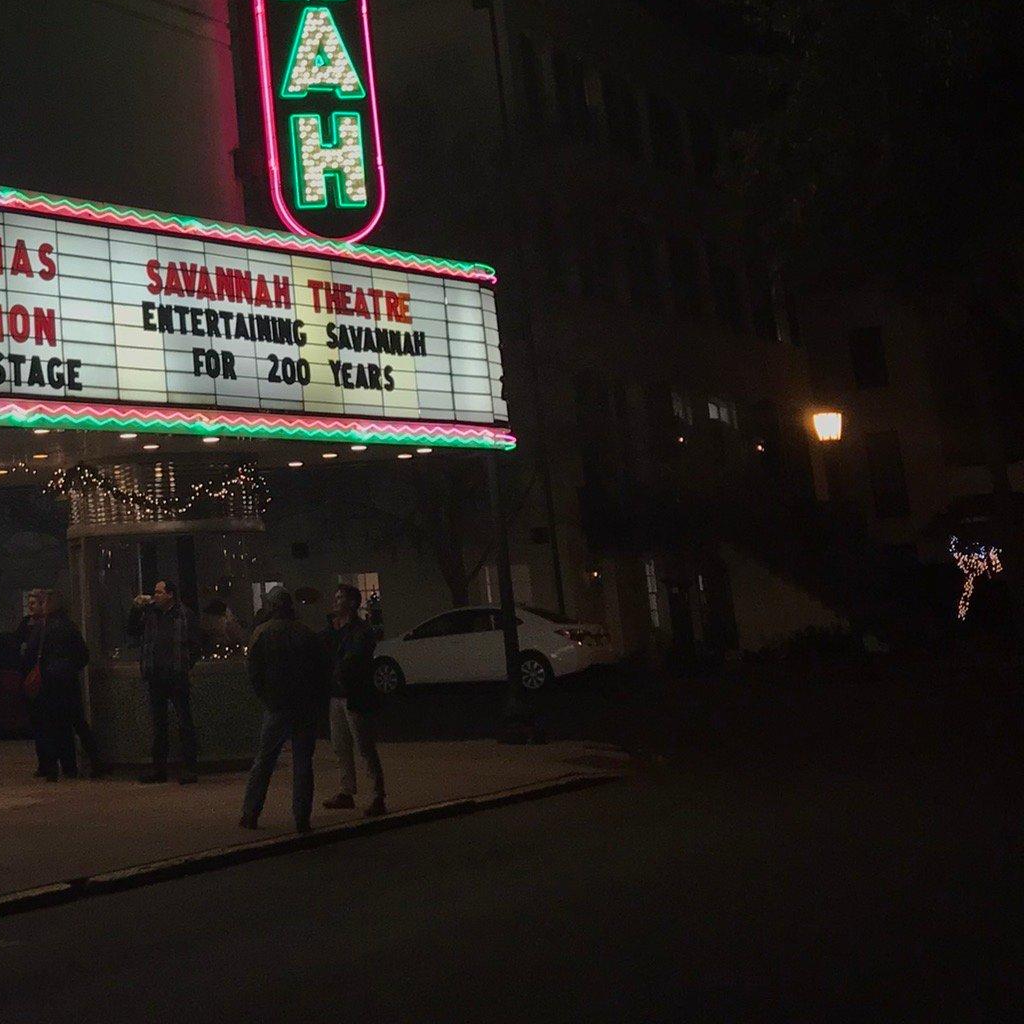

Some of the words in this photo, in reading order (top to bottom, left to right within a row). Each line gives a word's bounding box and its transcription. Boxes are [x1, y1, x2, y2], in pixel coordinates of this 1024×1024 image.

[146, 259, 292, 310] SAVANNAH
[308, 279, 412, 325] THEATRE
[142, 301, 307, 347] ENTERTAINING
[326, 322, 426, 356] SAVANNAH
[193, 348, 237, 380] FOR
[267, 353, 311, 386] 200
[328, 359, 395, 391] YEARS
